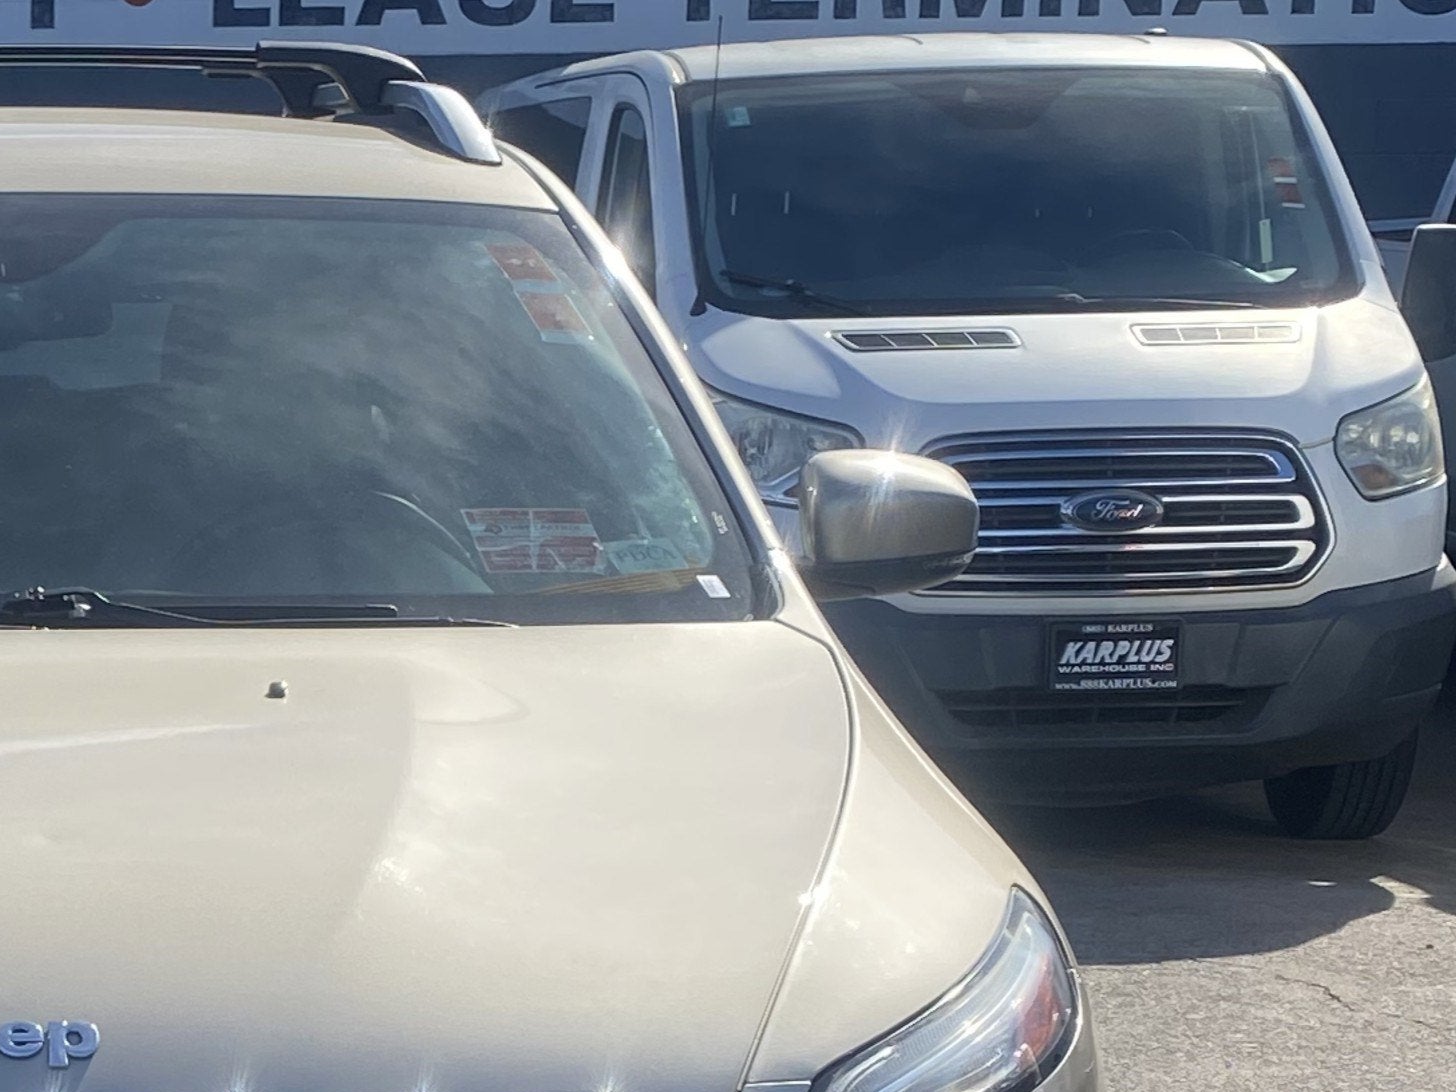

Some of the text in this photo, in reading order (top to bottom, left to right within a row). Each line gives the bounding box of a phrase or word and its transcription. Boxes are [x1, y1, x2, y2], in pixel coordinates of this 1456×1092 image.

[1091, 499, 1144, 520] Ford
[1107, 623, 1154, 633] KARPLUS
[1059, 639, 1175, 664] KARPLUS
[1057, 664, 1146, 673] WAREHOUSE
